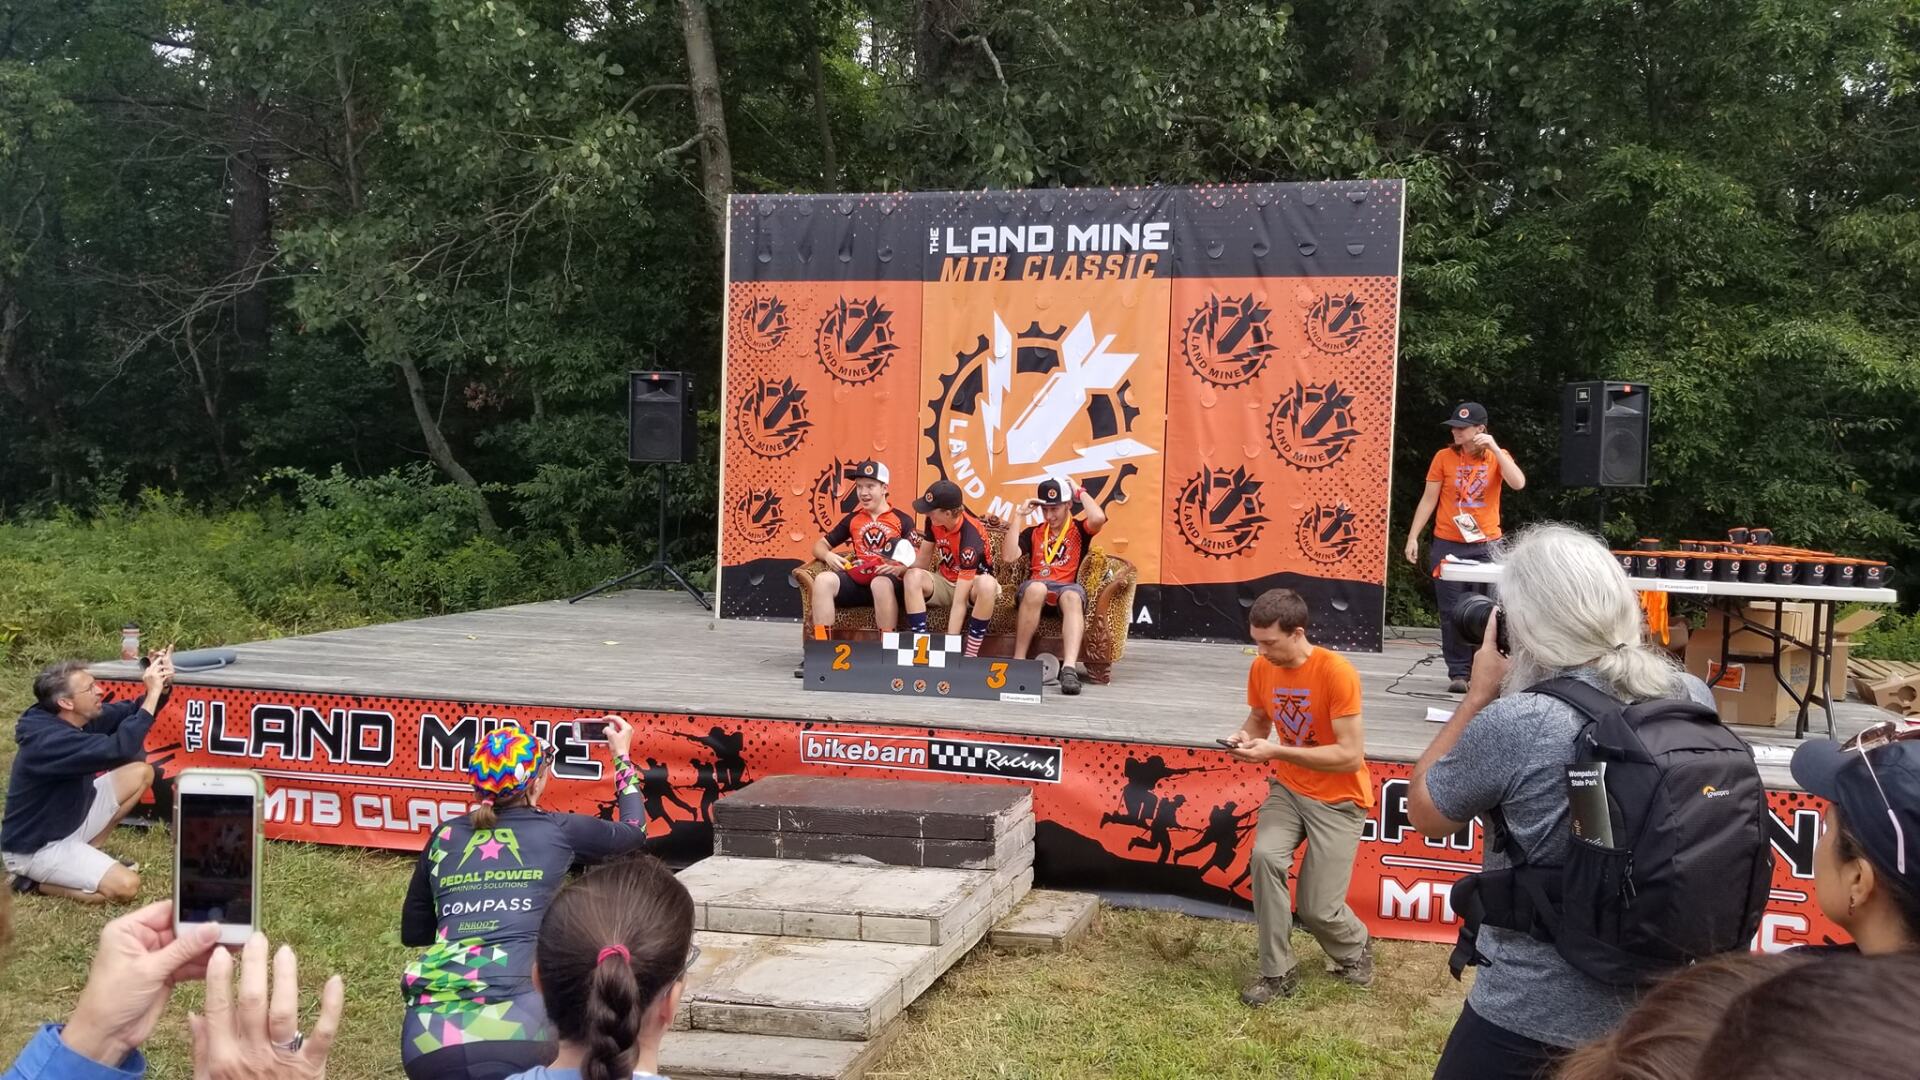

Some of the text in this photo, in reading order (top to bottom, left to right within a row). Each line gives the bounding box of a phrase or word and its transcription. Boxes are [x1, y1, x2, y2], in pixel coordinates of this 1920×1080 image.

[929, 222, 1170, 254] THE LAND MINE
[940, 253, 1159, 281] MTB CLASSIC
[1310, 320, 1345, 350] LAND MINE
[823, 336, 869, 377] LAND MINE
[1192, 335, 1242, 379] LAND MINE
[742, 412, 784, 451] LAND MINE
[1276, 419, 1326, 463] LAND MINE
[949, 418, 986, 499] LAND
[817, 495, 833, 527] LAND
[1184, 505, 1234, 549] LAND MINE
[1301, 529, 1336, 560] LAND MINE
[832, 644, 852, 670] 2
[912, 636, 931, 664] 1
[986, 662, 1009, 688] 3
[185, 699, 205, 753] THE
[207, 701, 396, 767] LAND
[806, 738, 1056, 777] bikebarn Racing
[1568, 769, 1599, 778] Wompatuck
[440, 869, 544, 887] PEDAL POWER
[483, 881, 529, 890] SOLUTIONS
[442, 898, 532, 917] COMPASS
